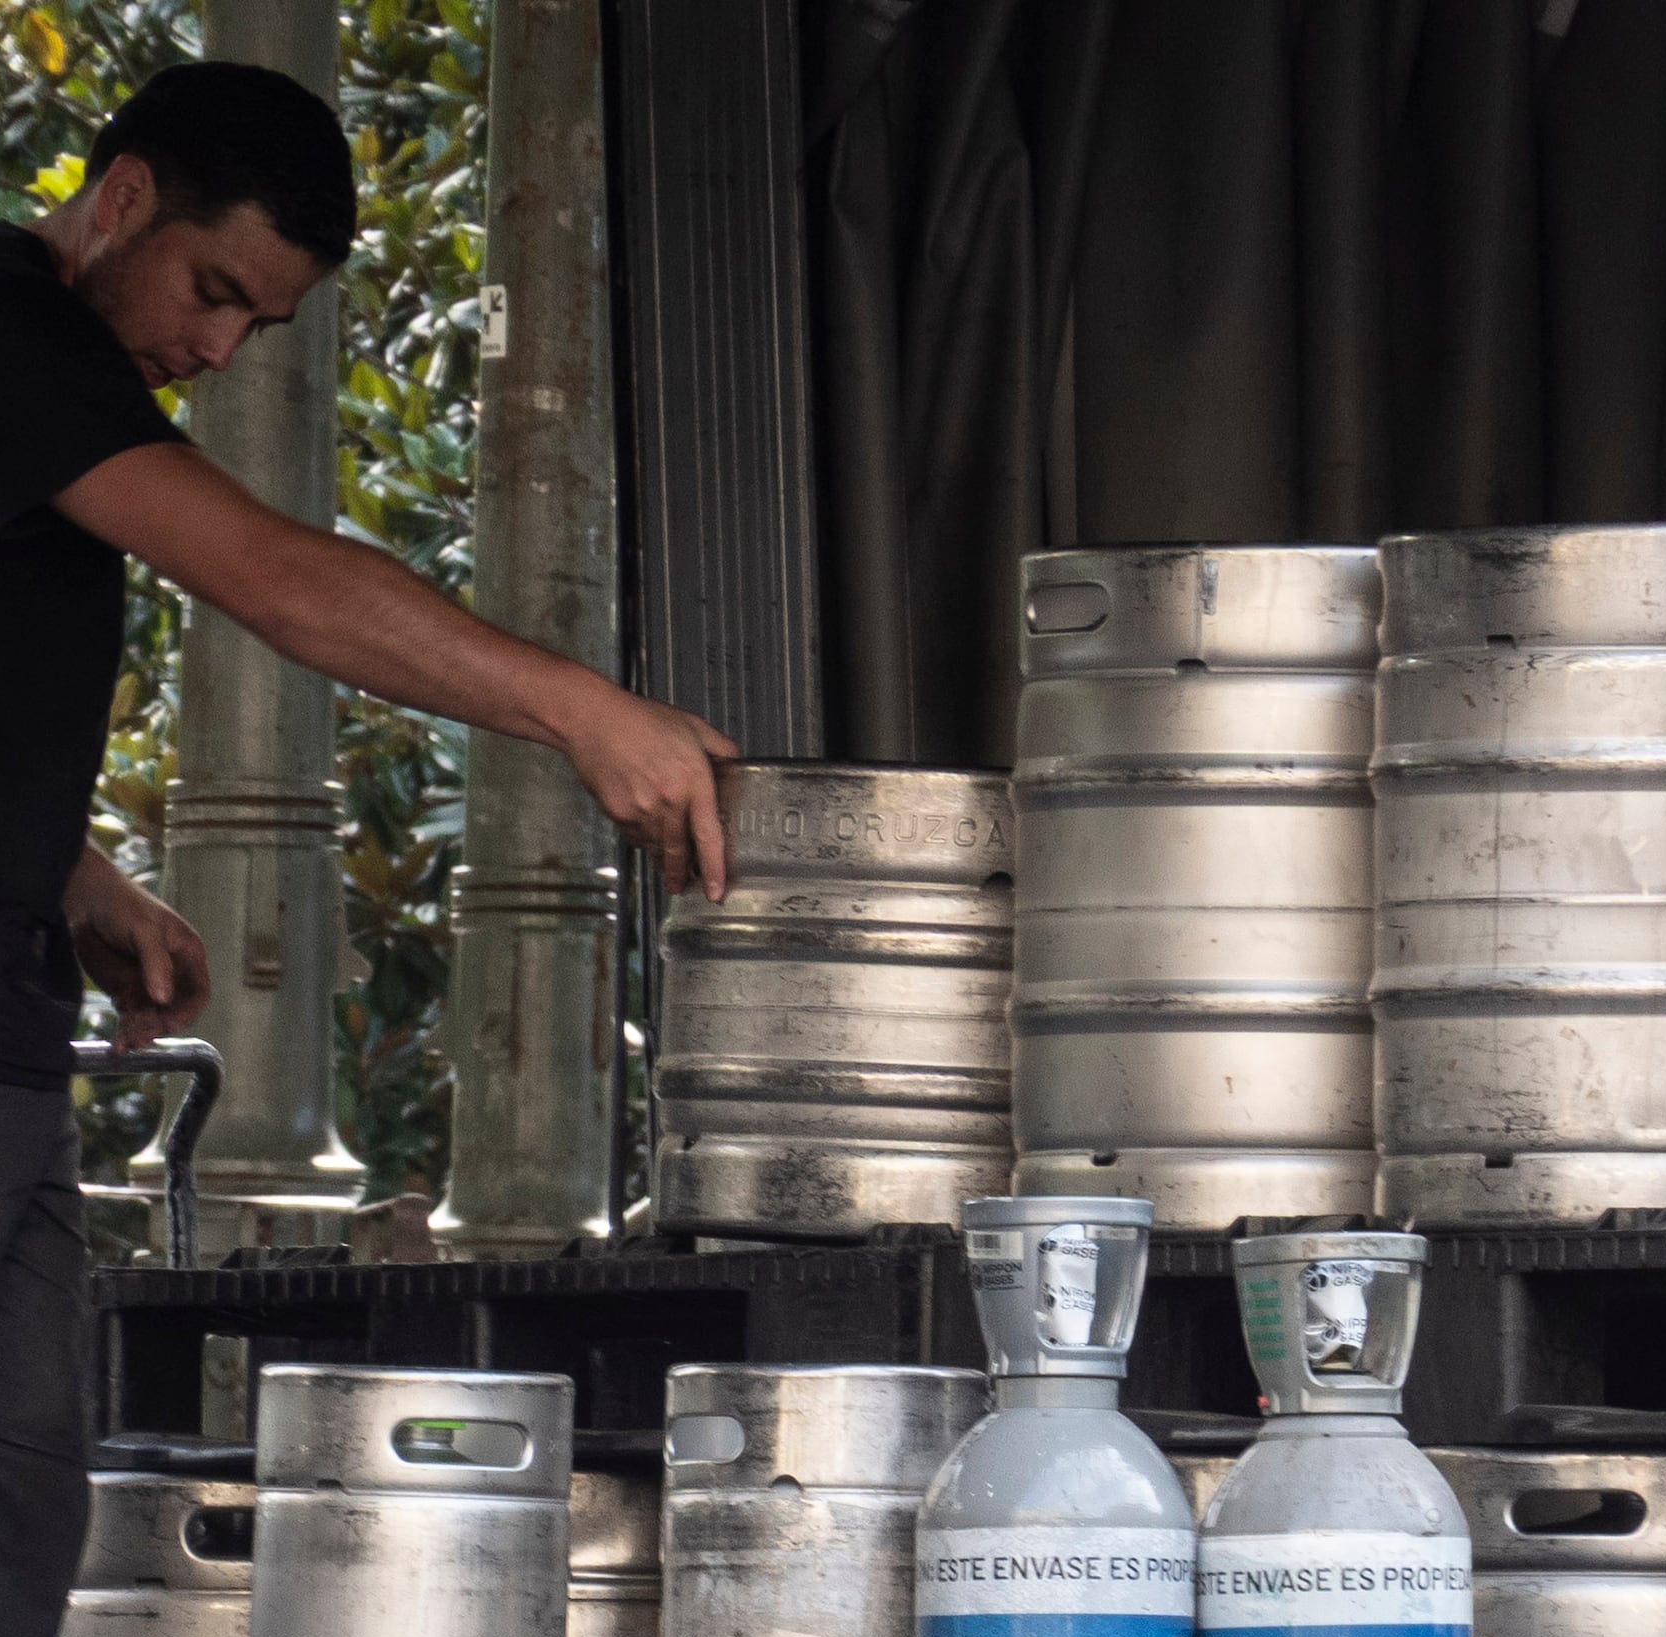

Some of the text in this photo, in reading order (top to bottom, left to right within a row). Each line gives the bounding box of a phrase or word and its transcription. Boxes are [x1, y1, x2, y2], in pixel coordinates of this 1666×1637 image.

[737, 808, 805, 839] UPO
[937, 1557, 985, 1583] ESTE
[993, 1555, 1102, 1580] ENVASE
[1110, 1556, 1140, 1580] ES
[1196, 1572, 1228, 1596] STE
[1233, 1567, 1332, 1593] ENVASE
[1341, 1567, 1375, 1591] ES
